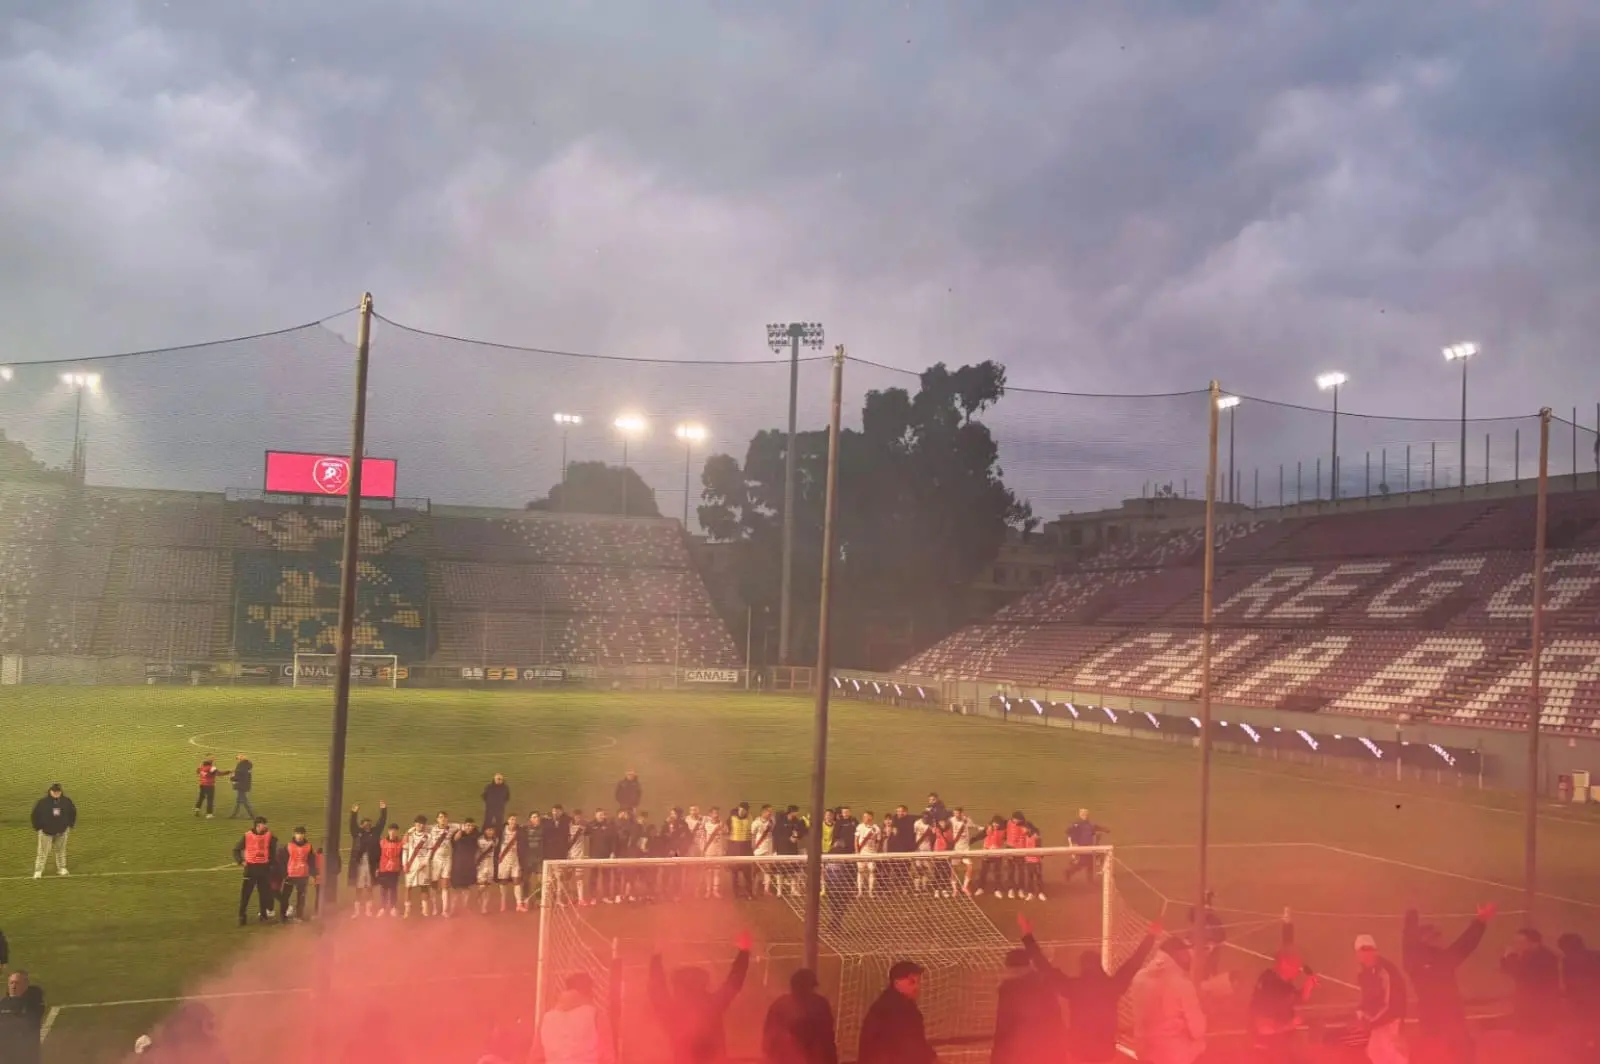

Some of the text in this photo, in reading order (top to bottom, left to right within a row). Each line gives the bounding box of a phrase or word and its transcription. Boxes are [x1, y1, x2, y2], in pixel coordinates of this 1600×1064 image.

[284, 664, 337, 678] CANAL
[687, 670, 737, 682] CANALE
[1073, 632, 1600, 728] CALABR
